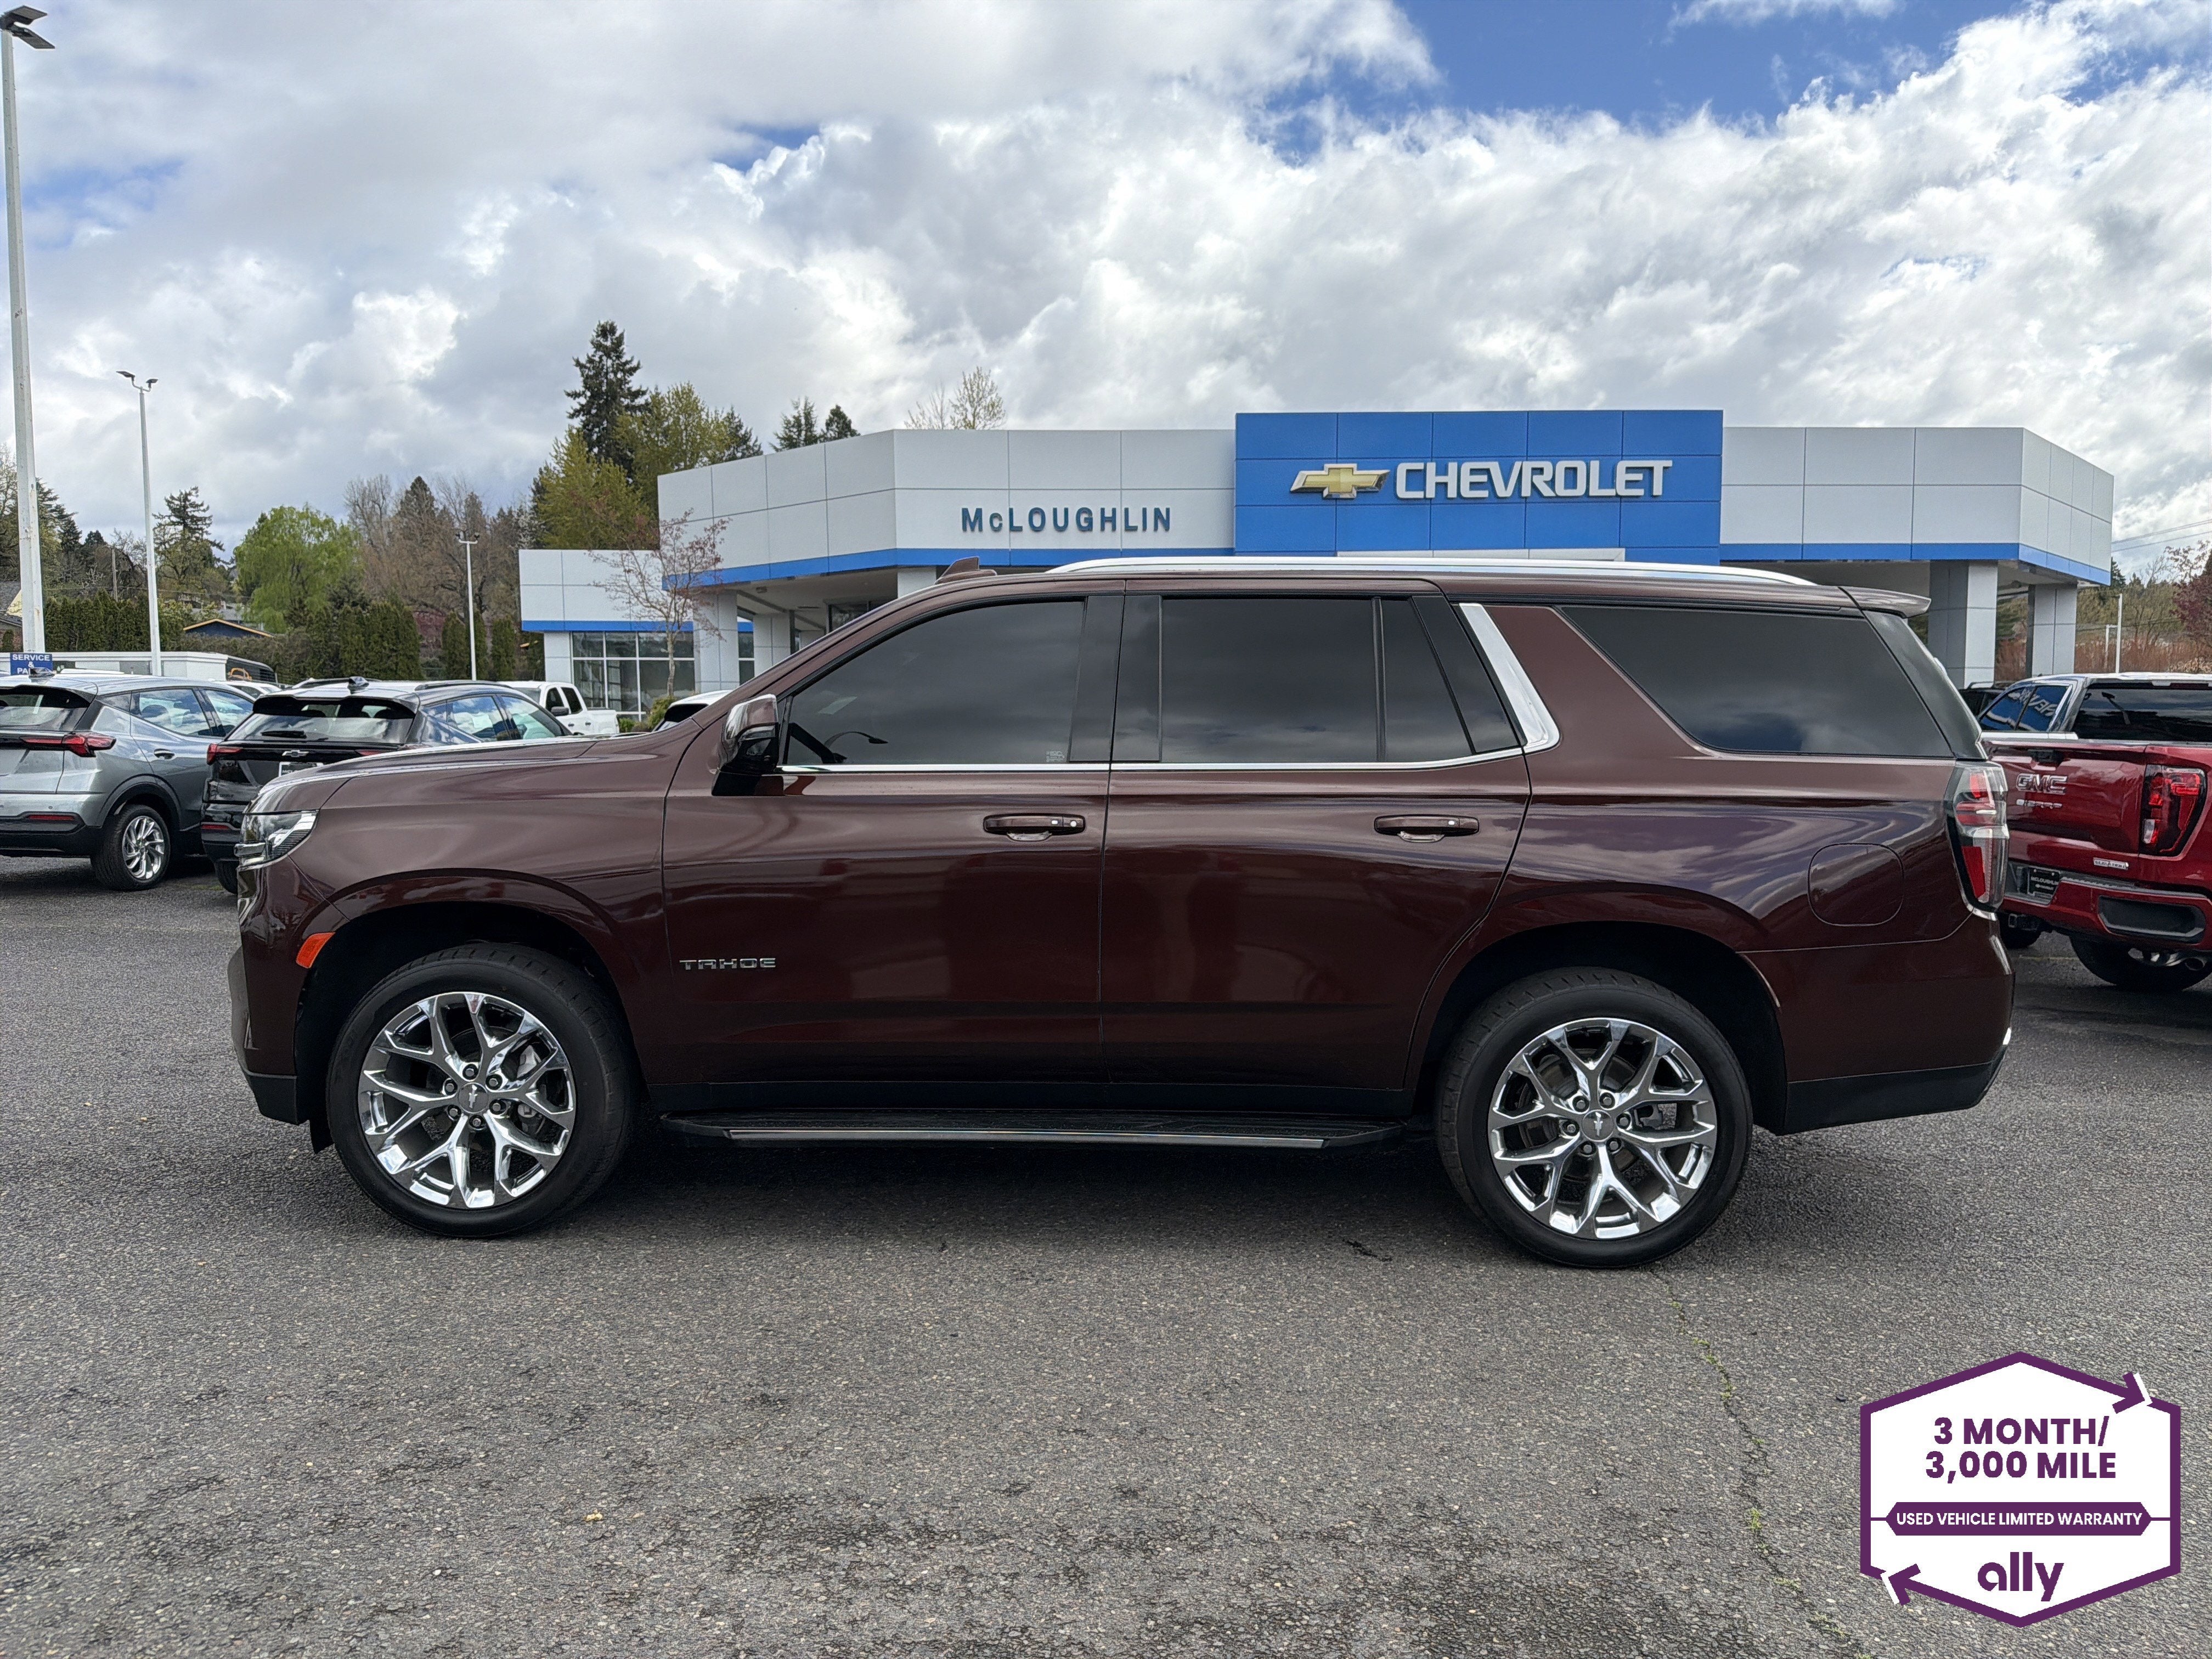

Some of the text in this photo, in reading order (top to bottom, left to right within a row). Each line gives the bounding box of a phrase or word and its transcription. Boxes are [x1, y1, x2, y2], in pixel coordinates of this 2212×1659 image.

[1396, 460, 1673, 499] CHEVROLET
[961, 507, 1170, 533] McLOUGHLIN
[2016, 773, 2067, 795] GMC
[679, 958, 776, 970] TAHOE
